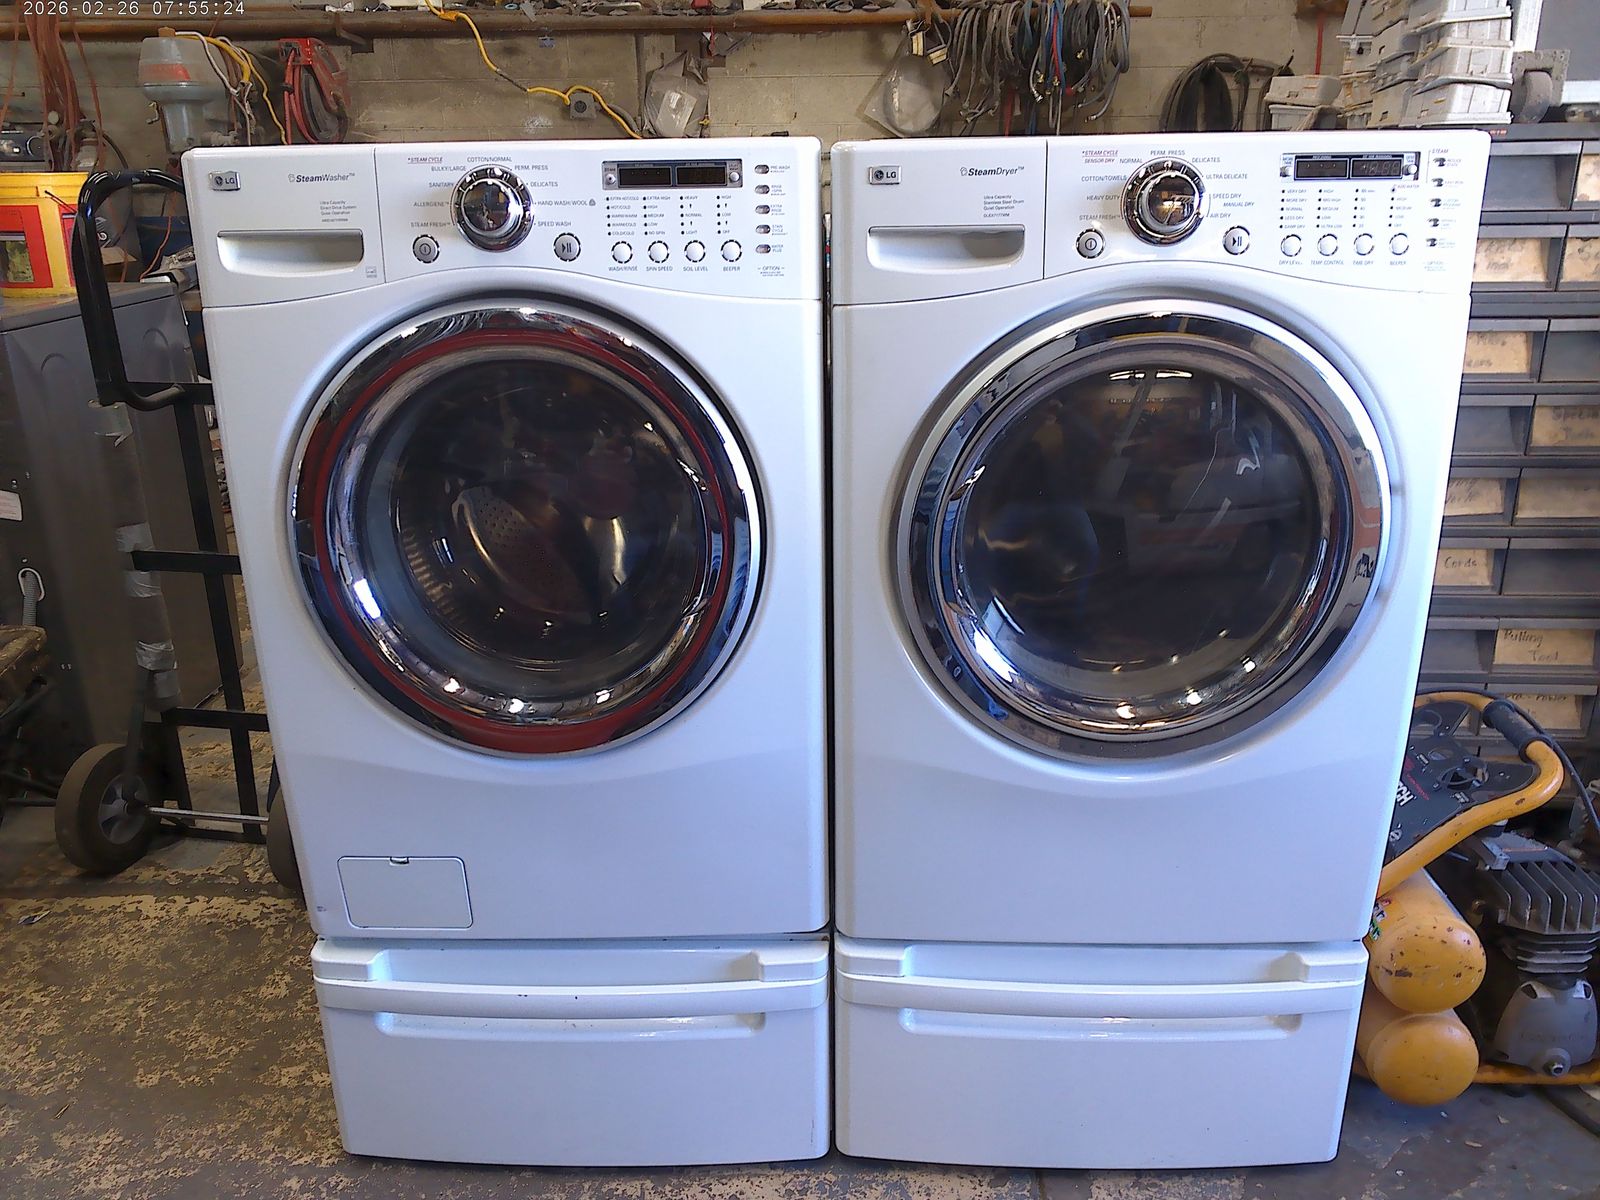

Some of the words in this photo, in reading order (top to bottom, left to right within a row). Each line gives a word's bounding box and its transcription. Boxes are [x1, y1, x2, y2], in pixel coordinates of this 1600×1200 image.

[886, 171, 897, 179] LG
[225, 177, 236, 185] LG
[1444, 556, 1477, 569] Cords
